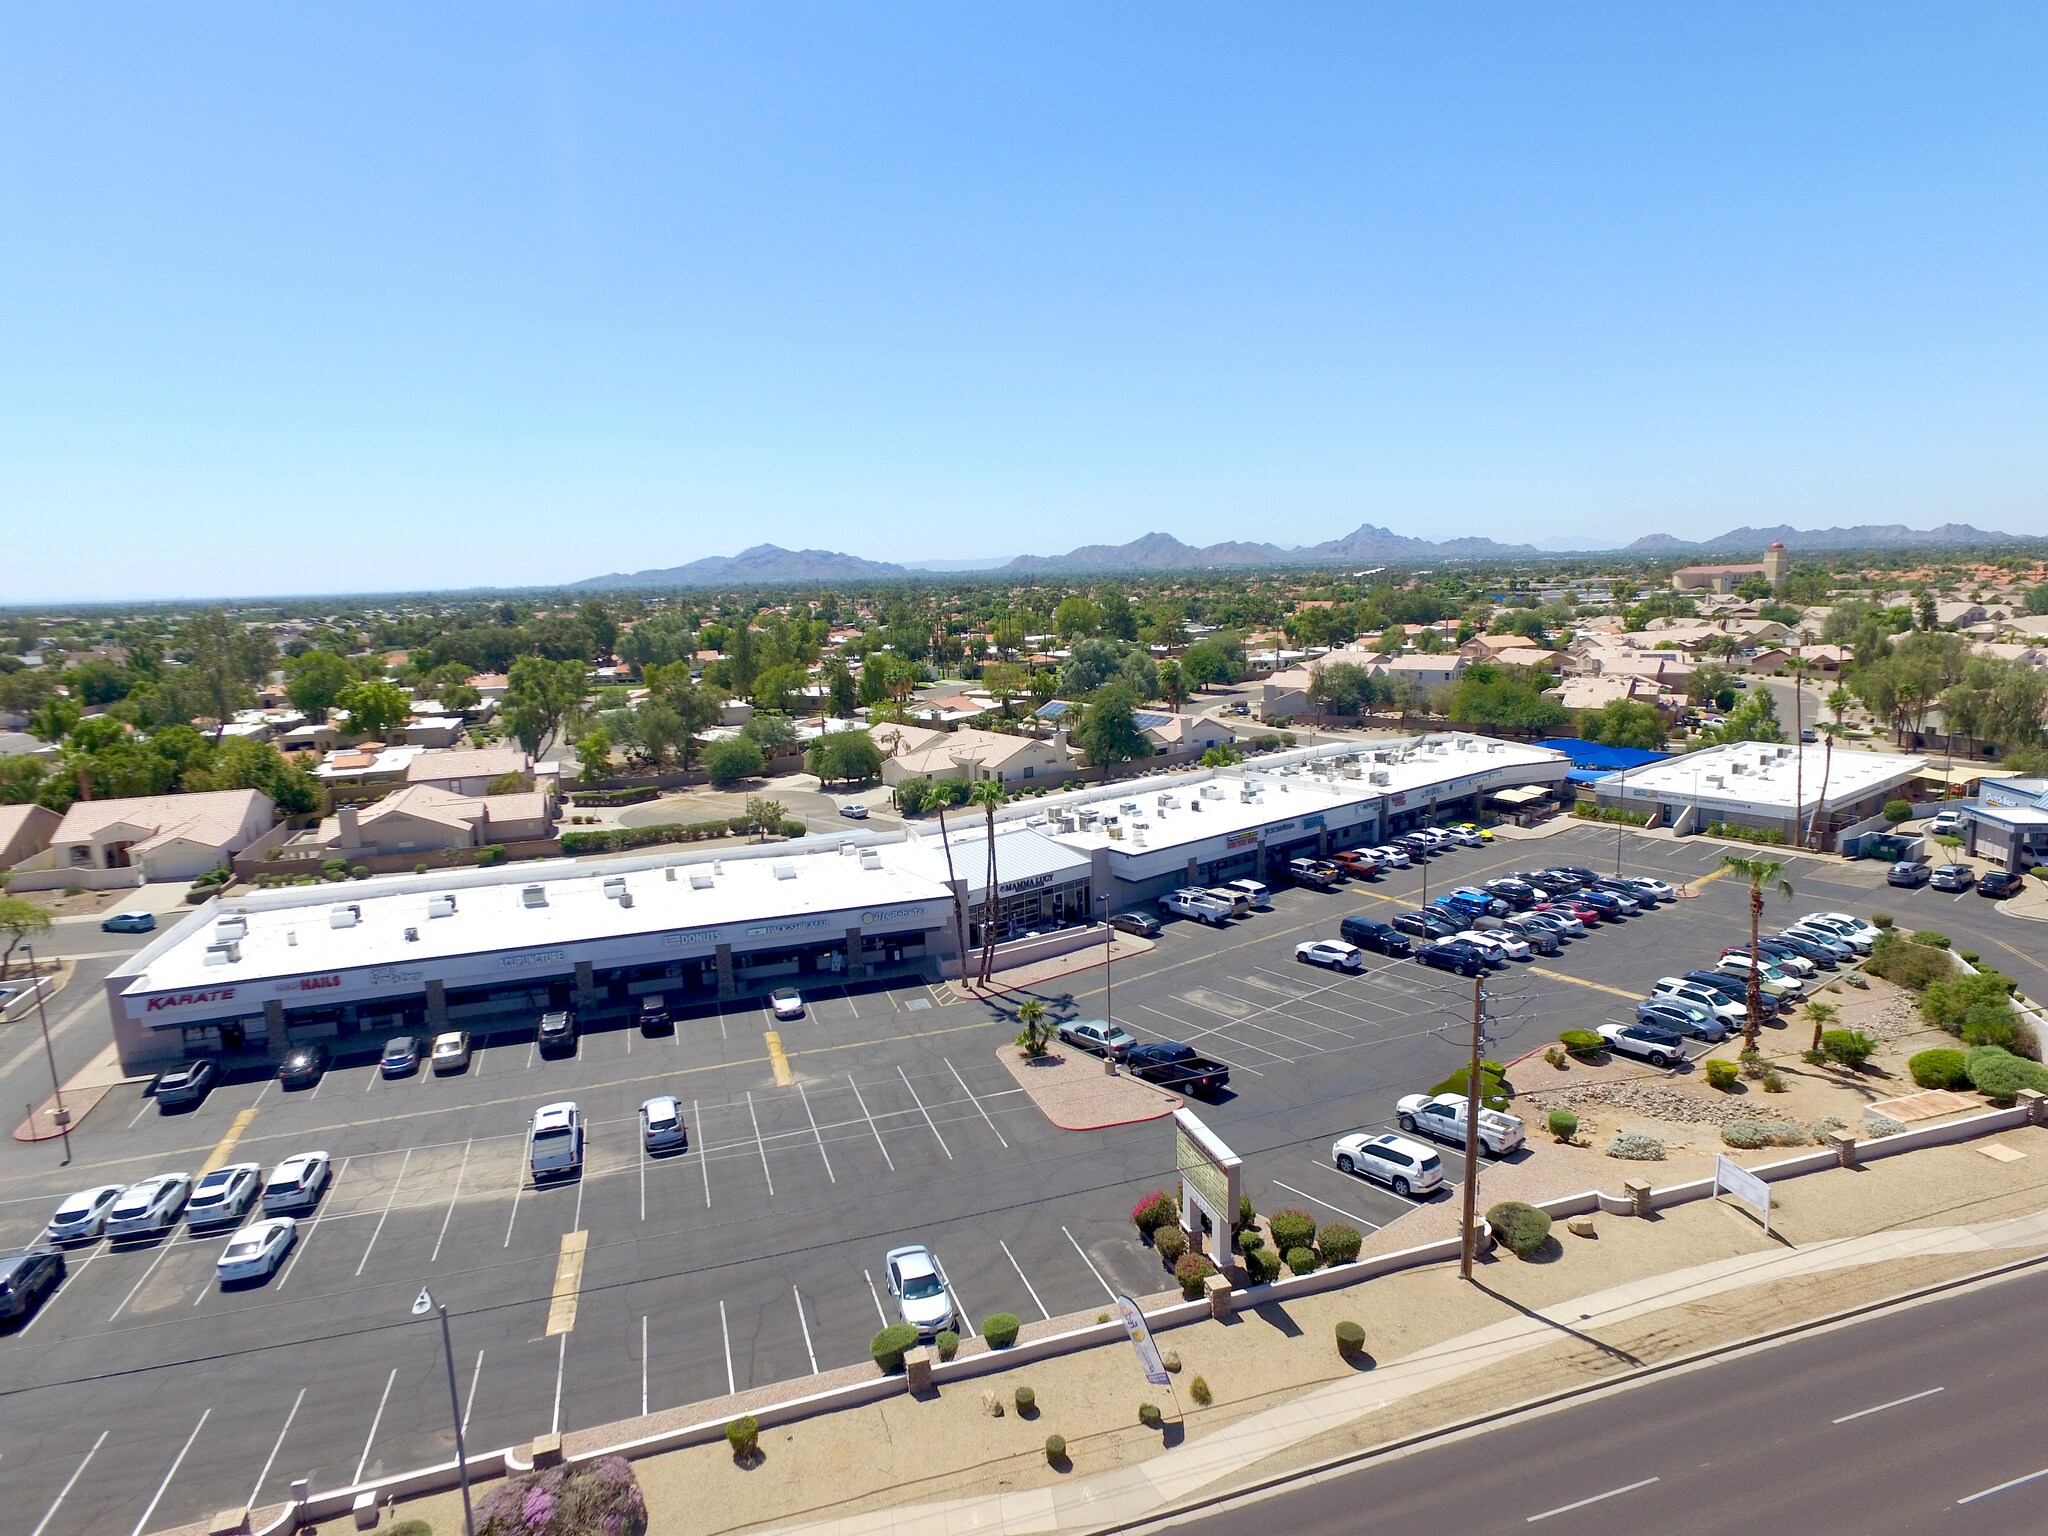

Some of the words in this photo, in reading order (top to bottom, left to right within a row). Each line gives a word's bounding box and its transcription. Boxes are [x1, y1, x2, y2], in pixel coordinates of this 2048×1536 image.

[1005, 878, 1035, 893] MAMMA
[1035, 874, 1054, 885] LUCY
[681, 930, 720, 945] DONUTS
[498, 951, 564, 969] ACUPUNCTURE
[300, 975, 341, 991] NAILS
[146, 988, 236, 1012] KARATE
